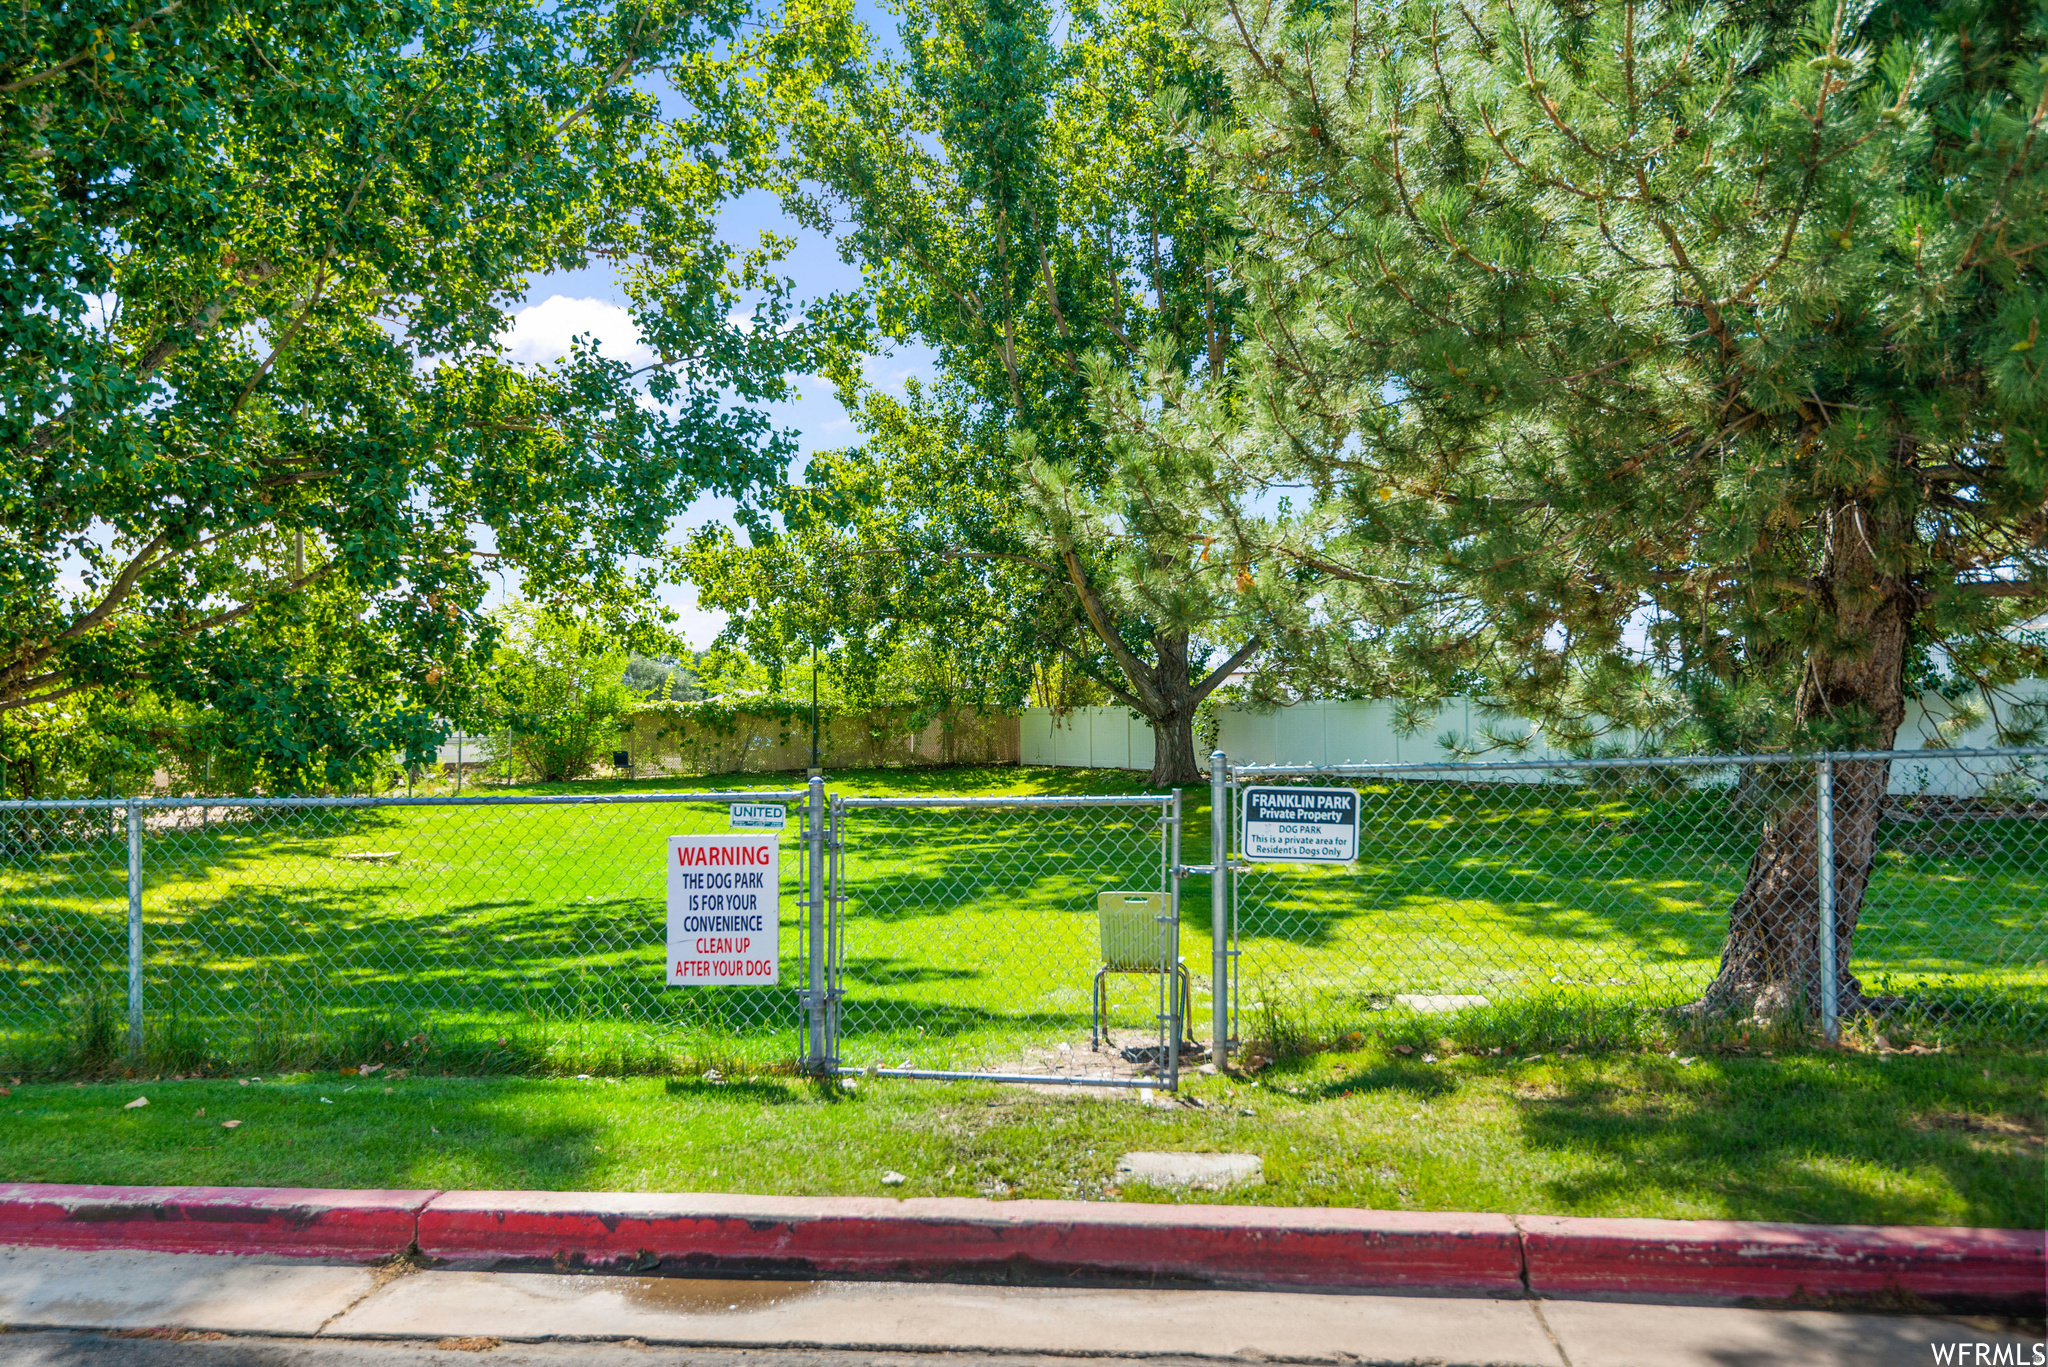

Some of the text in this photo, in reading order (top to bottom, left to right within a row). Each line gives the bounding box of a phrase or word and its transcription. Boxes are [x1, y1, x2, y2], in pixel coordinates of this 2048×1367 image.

[1251, 793, 1352, 810] FRANKLIN PARK
[734, 806, 782, 818] UNITED
[1259, 807, 1343, 823] Private Property
[1278, 824, 1322, 835] DOG PARK
[1251, 834, 1268, 843] This
[1269, 835, 1276, 843] is
[1284, 835, 1313, 845] private
[1335, 836, 1347, 845] for
[677, 846, 770, 866] WARNING
[1256, 845, 1341, 857] Resident's Dogs Only
[682, 872, 764, 889] THE DOG PARK
[689, 894, 757, 911] IS FOR YOUR
[683, 915, 763, 932] CONVENIENCE
[696, 937, 751, 954] CLEAN UP
[675, 960, 771, 976] AFTER YOUR DOG
